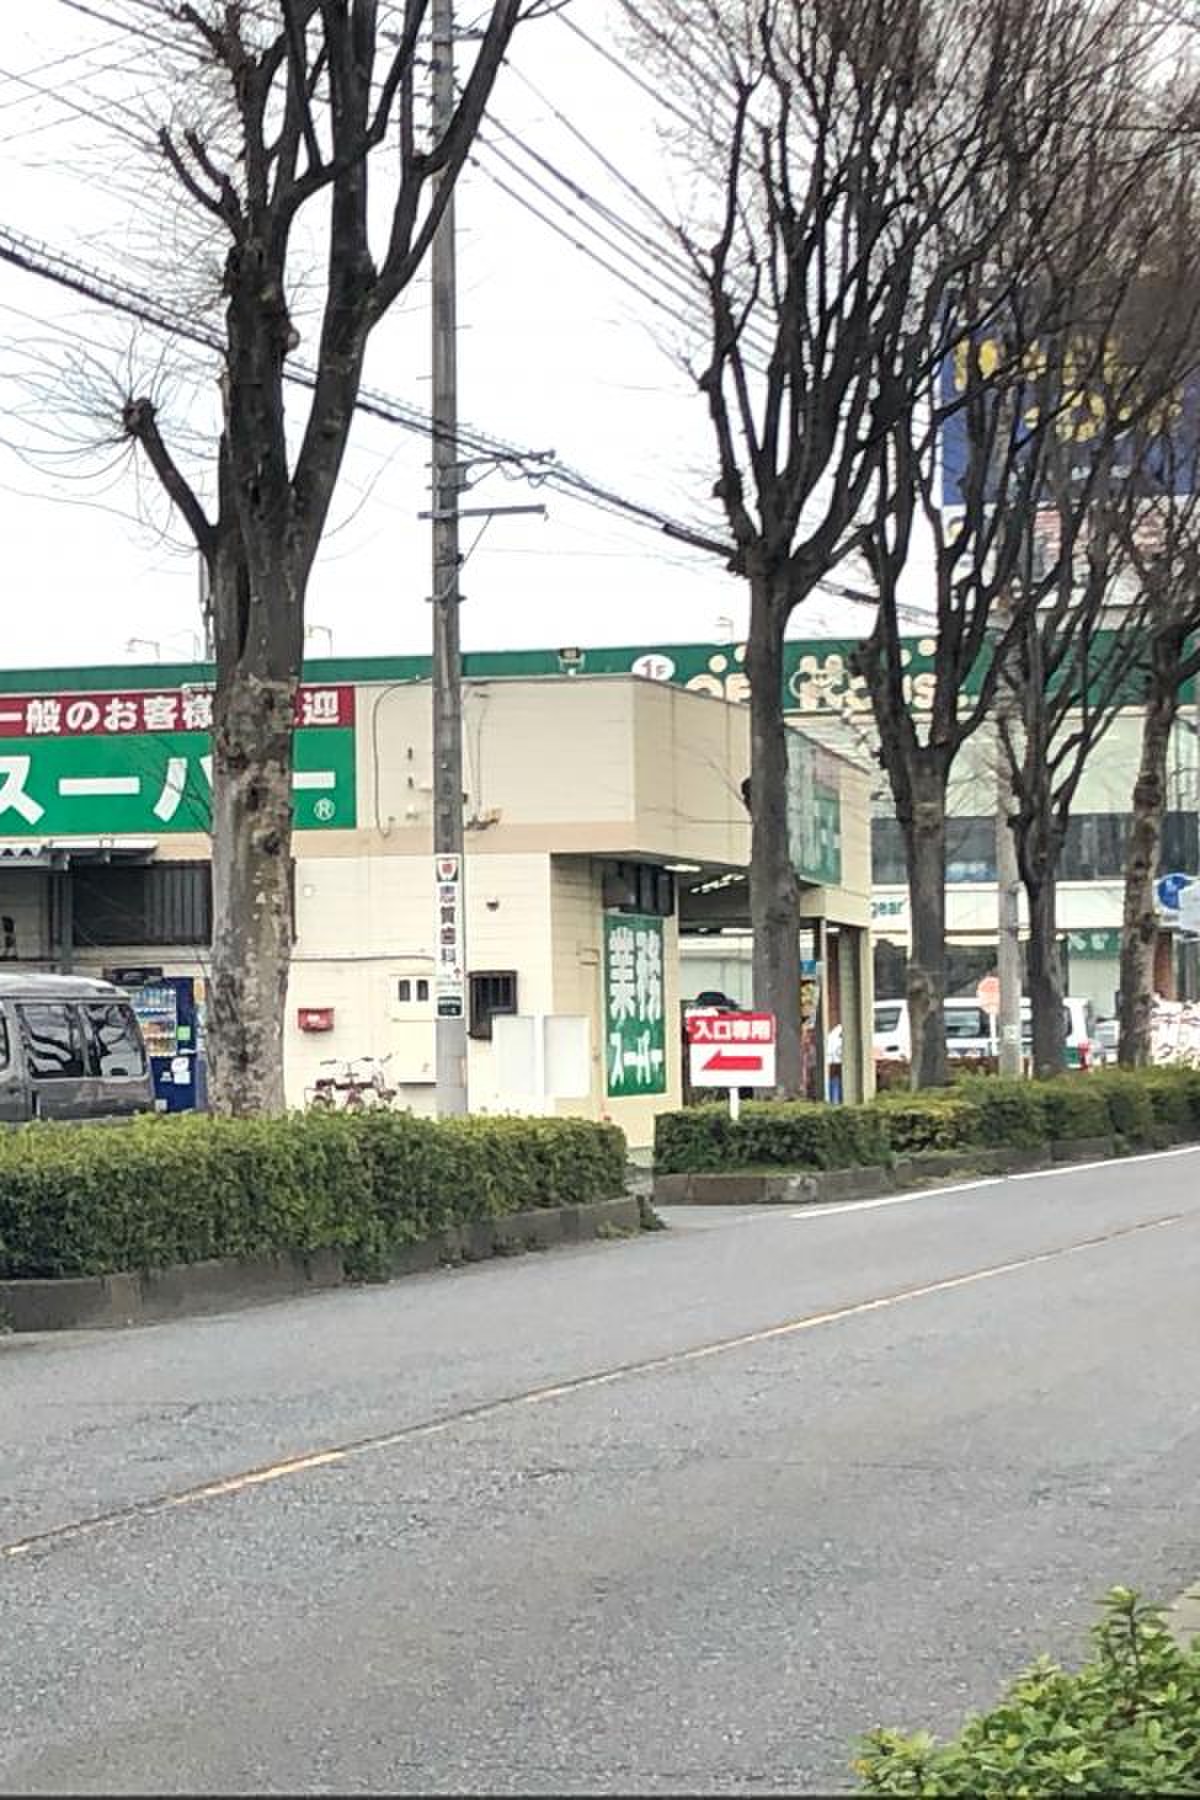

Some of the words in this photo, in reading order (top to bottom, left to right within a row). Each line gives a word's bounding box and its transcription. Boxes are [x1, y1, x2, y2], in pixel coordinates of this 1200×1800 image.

[609, 926, 661, 1022] 業務
[609, 1030, 662, 1088] スーパー
[692, 1019, 771, 1041] 入口専用
